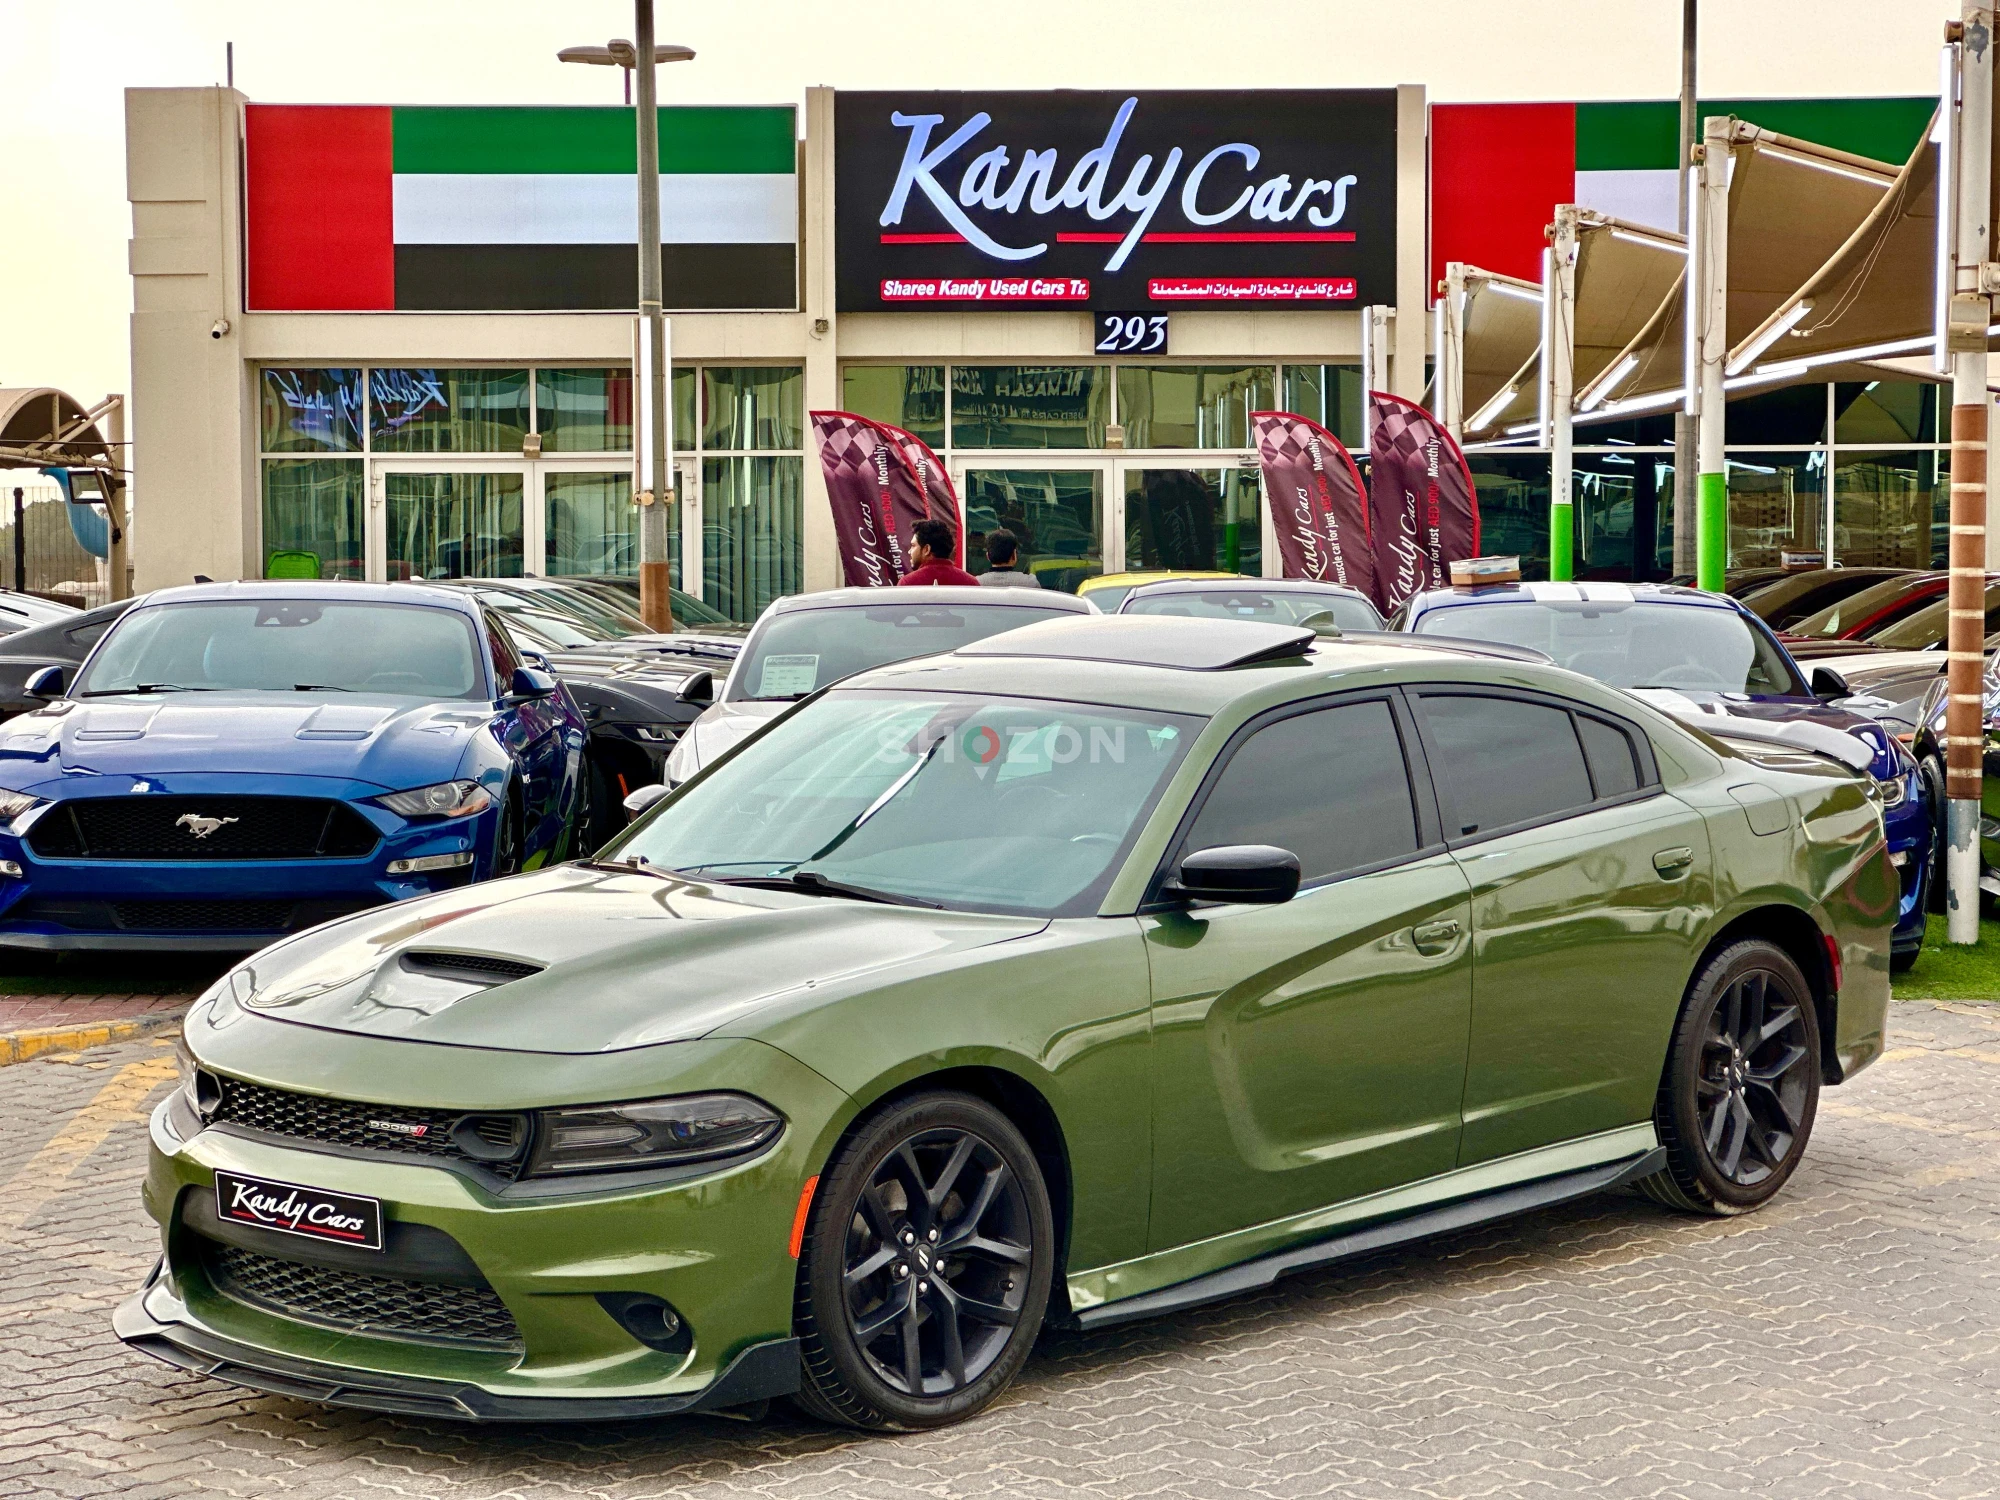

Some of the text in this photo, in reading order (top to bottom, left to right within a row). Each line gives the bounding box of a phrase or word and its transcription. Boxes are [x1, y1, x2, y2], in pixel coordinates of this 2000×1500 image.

[880, 97, 1357, 271] Kandy Cars
[884, 280, 1087, 299] Sharee Kandy Used Cars Tr.
[1152, 282, 1353, 298] شارع كاندي لتجارة السيارات المستعملة
[1096, 316, 1168, 351] 293
[875, 443, 889, 485] Monthly
[1308, 437, 1323, 471] Monthly
[1426, 438, 1441, 478] Monthly
[1295, 487, 1312, 524] Cars
[1400, 489, 1417, 536] Cars
[1428, 503, 1440, 527] AED
[858, 501, 877, 546] Cars
[1324, 511, 1339, 529] just
[887, 535, 902, 555] just
[1328, 528, 1338, 541] for
[1428, 528, 1441, 548] just
[1332, 541, 1341, 555] car
[1429, 547, 1440, 562] for
[892, 554, 902, 569] for
[1333, 555, 1348, 584] muscle
[1432, 562, 1441, 578] car
[369, 1120, 416, 1134] DODGE
[231, 1181, 365, 1231] Kandy Cars
